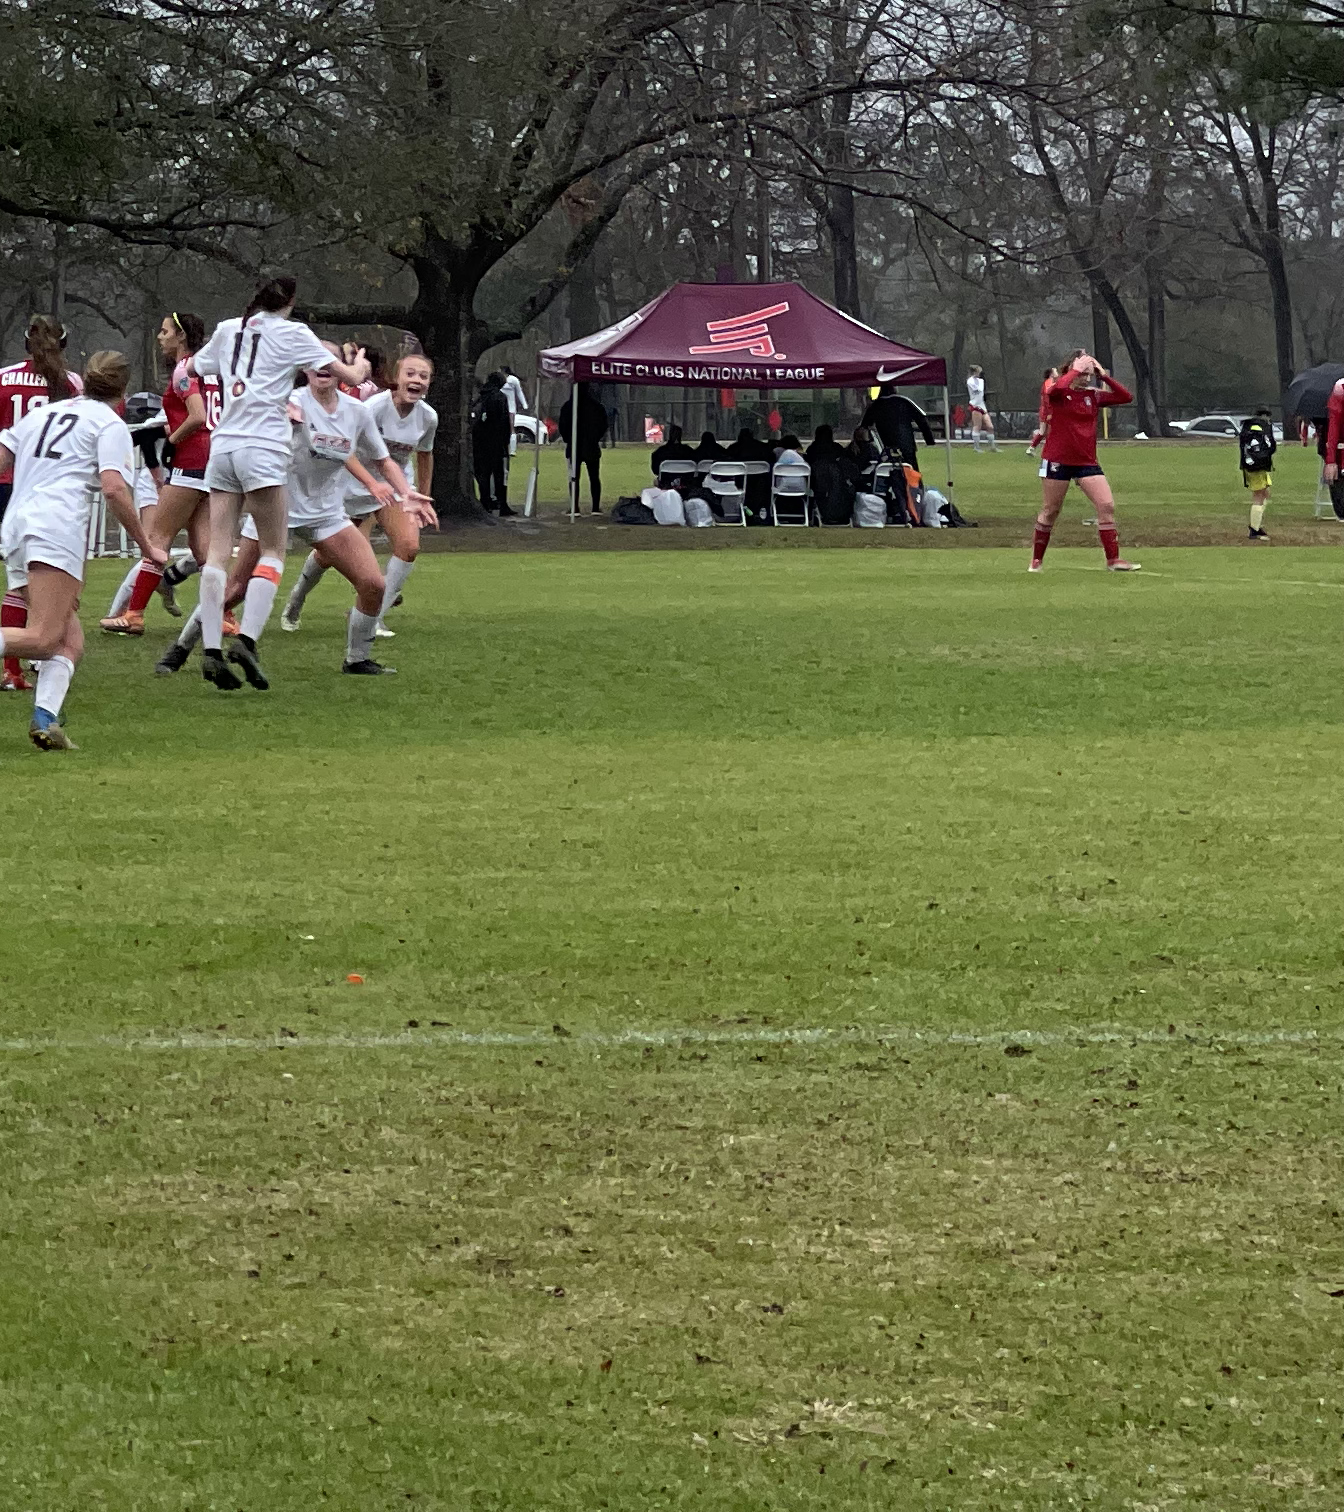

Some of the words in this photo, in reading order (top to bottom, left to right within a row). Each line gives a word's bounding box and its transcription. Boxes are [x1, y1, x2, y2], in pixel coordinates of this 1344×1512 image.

[231, 332, 261, 378] 11
[591, 361, 632, 376] ELITE
[635, 364, 684, 378] CLUBS
[688, 364, 762, 381] NATIONAL
[766, 367, 825, 381] LEAGUE
[1, 371, 48, 387] CHALLEN
[206, 390, 222, 431] 16
[34, 411, 79, 460] 12
